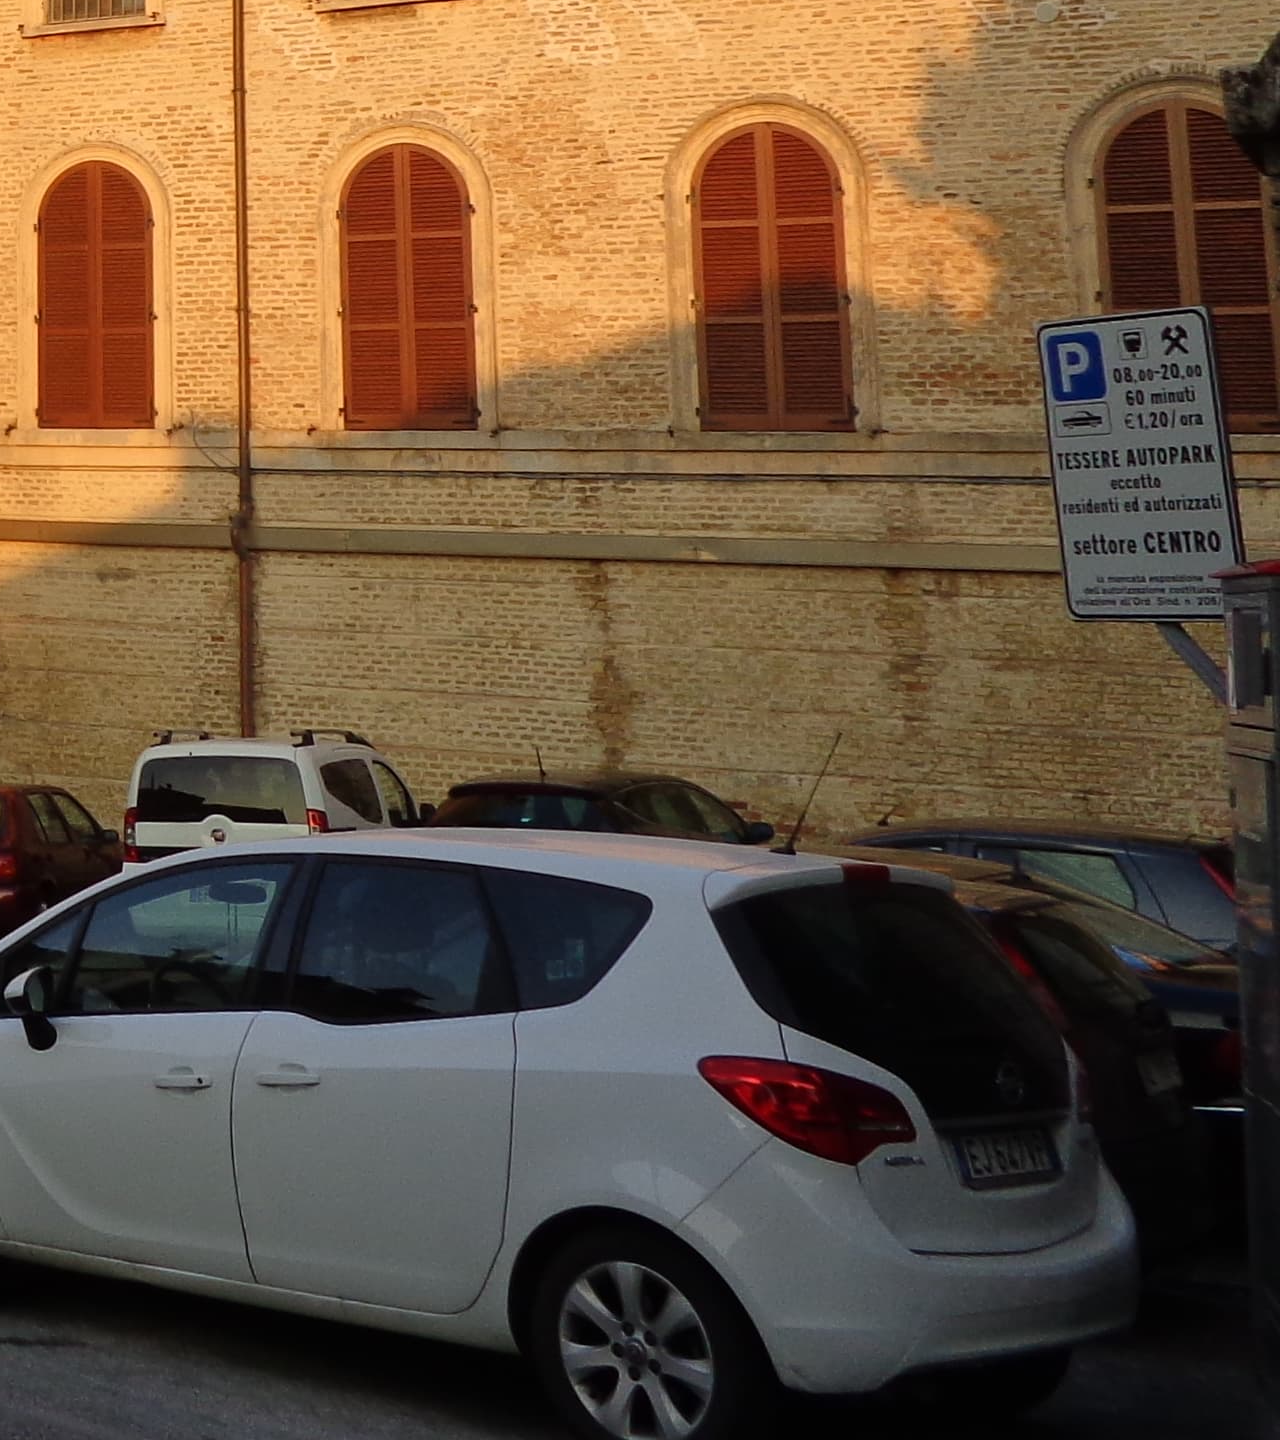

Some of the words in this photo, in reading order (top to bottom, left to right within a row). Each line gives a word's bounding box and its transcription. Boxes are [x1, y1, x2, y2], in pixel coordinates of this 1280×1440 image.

[1056, 342, 1090, 393] P
[1126, 390, 1144, 406] 60
[1151, 385, 1196, 404] minuti
[1056, 449, 1121, 470] TESSERE
[1127, 444, 1216, 466] AUTOPARK
[1110, 473, 1162, 490] eccetto
[1062, 497, 1119, 515] residenti
[1124, 497, 1140, 512] ed
[1145, 493, 1223, 511] autorizzati
[1073, 534, 1137, 555] settore
[1143, 530, 1222, 554] CENTRO
